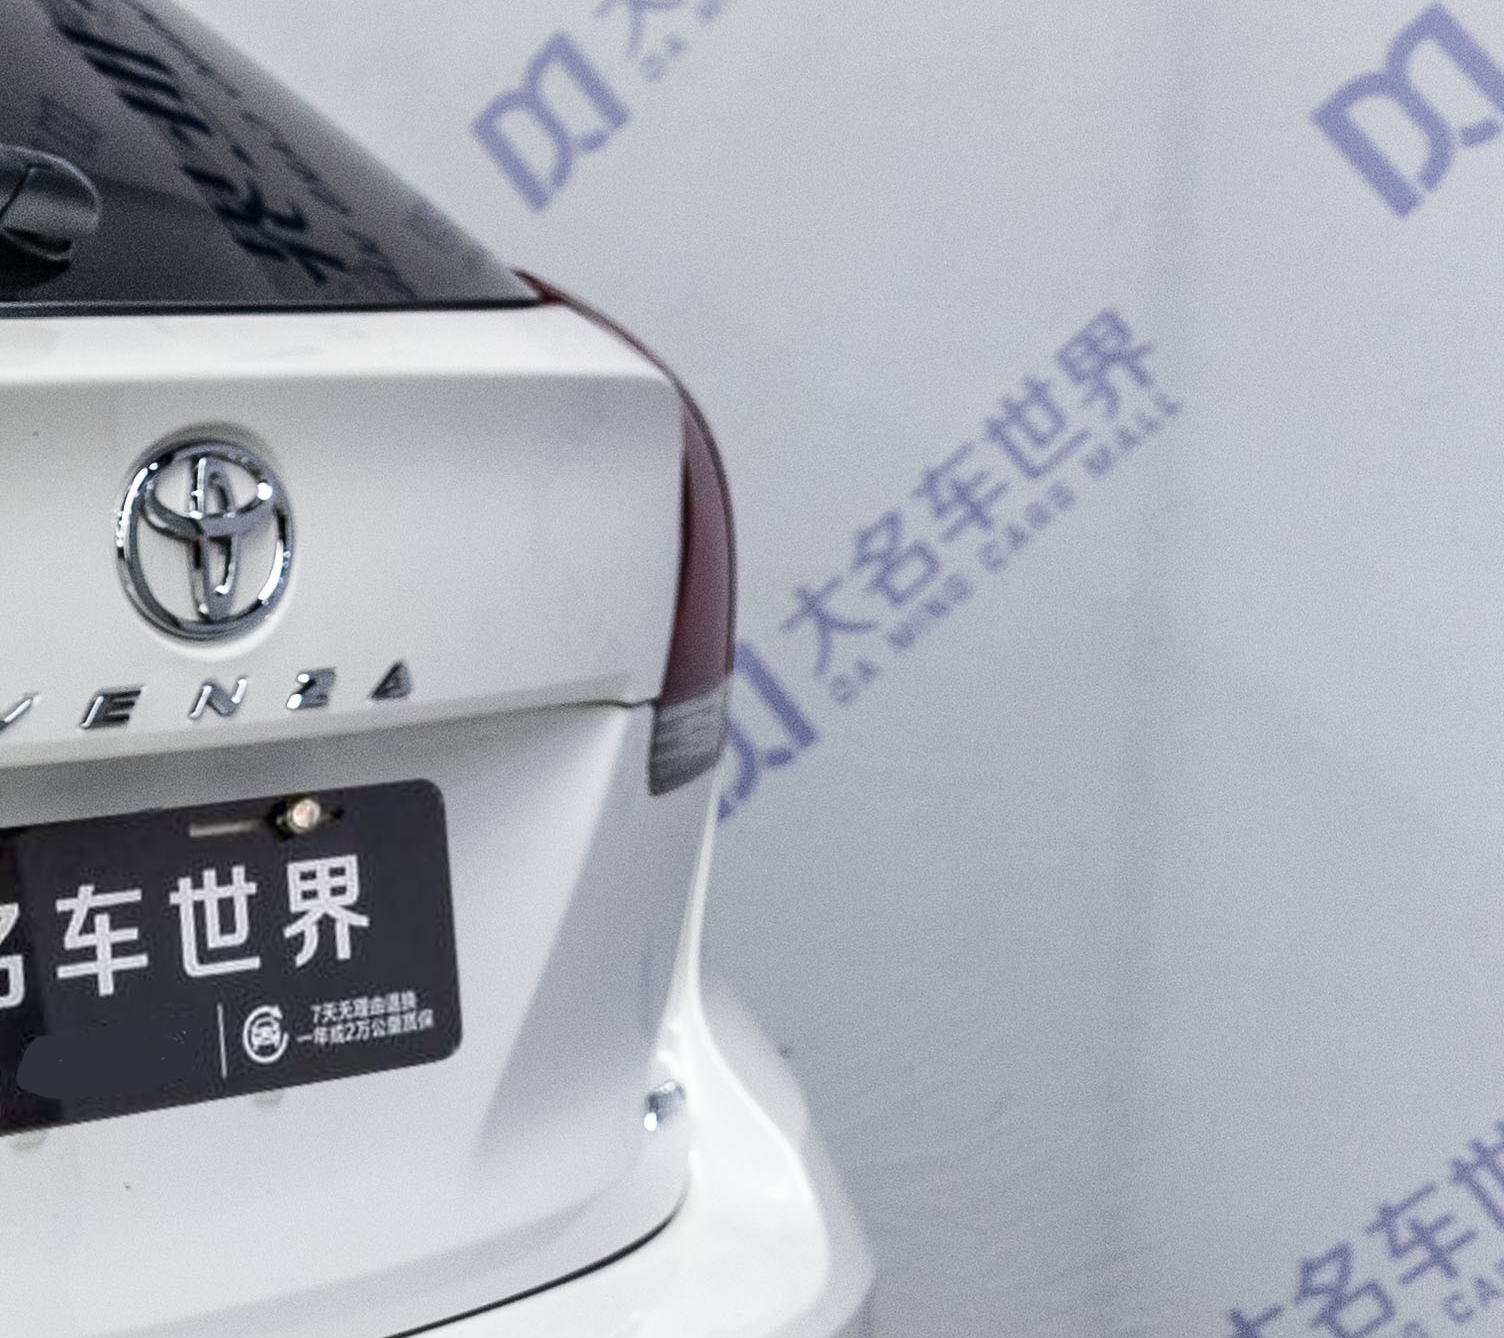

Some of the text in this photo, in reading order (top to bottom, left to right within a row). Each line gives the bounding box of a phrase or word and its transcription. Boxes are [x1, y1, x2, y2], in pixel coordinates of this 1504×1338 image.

[778, 306, 1160, 683] 大名车世界
